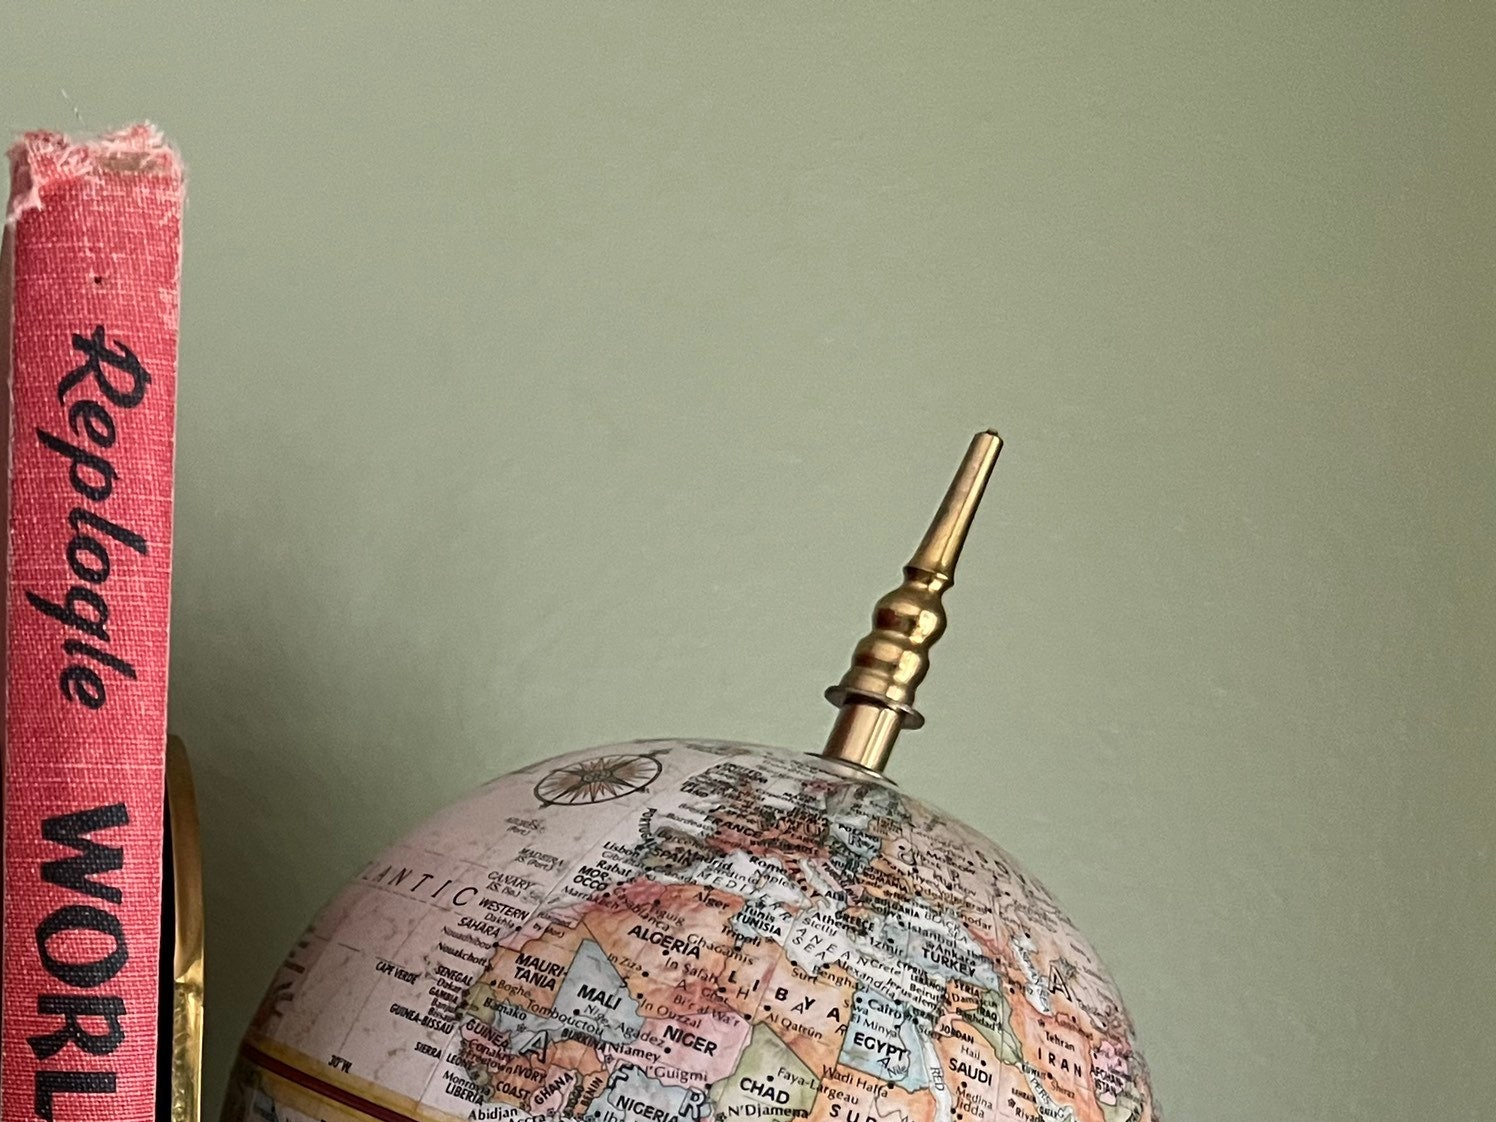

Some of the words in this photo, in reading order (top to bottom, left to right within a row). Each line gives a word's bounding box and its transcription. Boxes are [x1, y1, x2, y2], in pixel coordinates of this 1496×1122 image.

[25, 324, 152, 713] Replogle
[704, 813, 764, 839] FRANCE
[478, 896, 531, 922] WESTERN
[457, 916, 502, 940] SAHARA
[736, 912, 783, 937] TUNISIA
[626, 924, 702, 960] ALGERIA
[920, 945, 977, 978] TURKEY
[512, 966, 557, 992] TANIA
[577, 983, 622, 1012] MALI
[867, 997, 904, 1021] Cairo
[388, 1003, 455, 1036] GUINEA-BISSAU
[464, 1018, 510, 1050] GUINEA
[663, 1024, 718, 1056] NIGER
[853, 1031, 907, 1062] EGYPT
[513, 1063, 548, 1085] IVORY
[948, 1056, 994, 1087] SAUDI
[1037, 1047, 1083, 1078] IRAN
[495, 1080, 533, 1101] COAST
[533, 1072, 575, 1106] GHANA
[739, 1076, 791, 1106] CHAD
[777, 1066, 860, 1106] Faya-Largeau
[728, 1104, 809, 1120] N'Djamena
